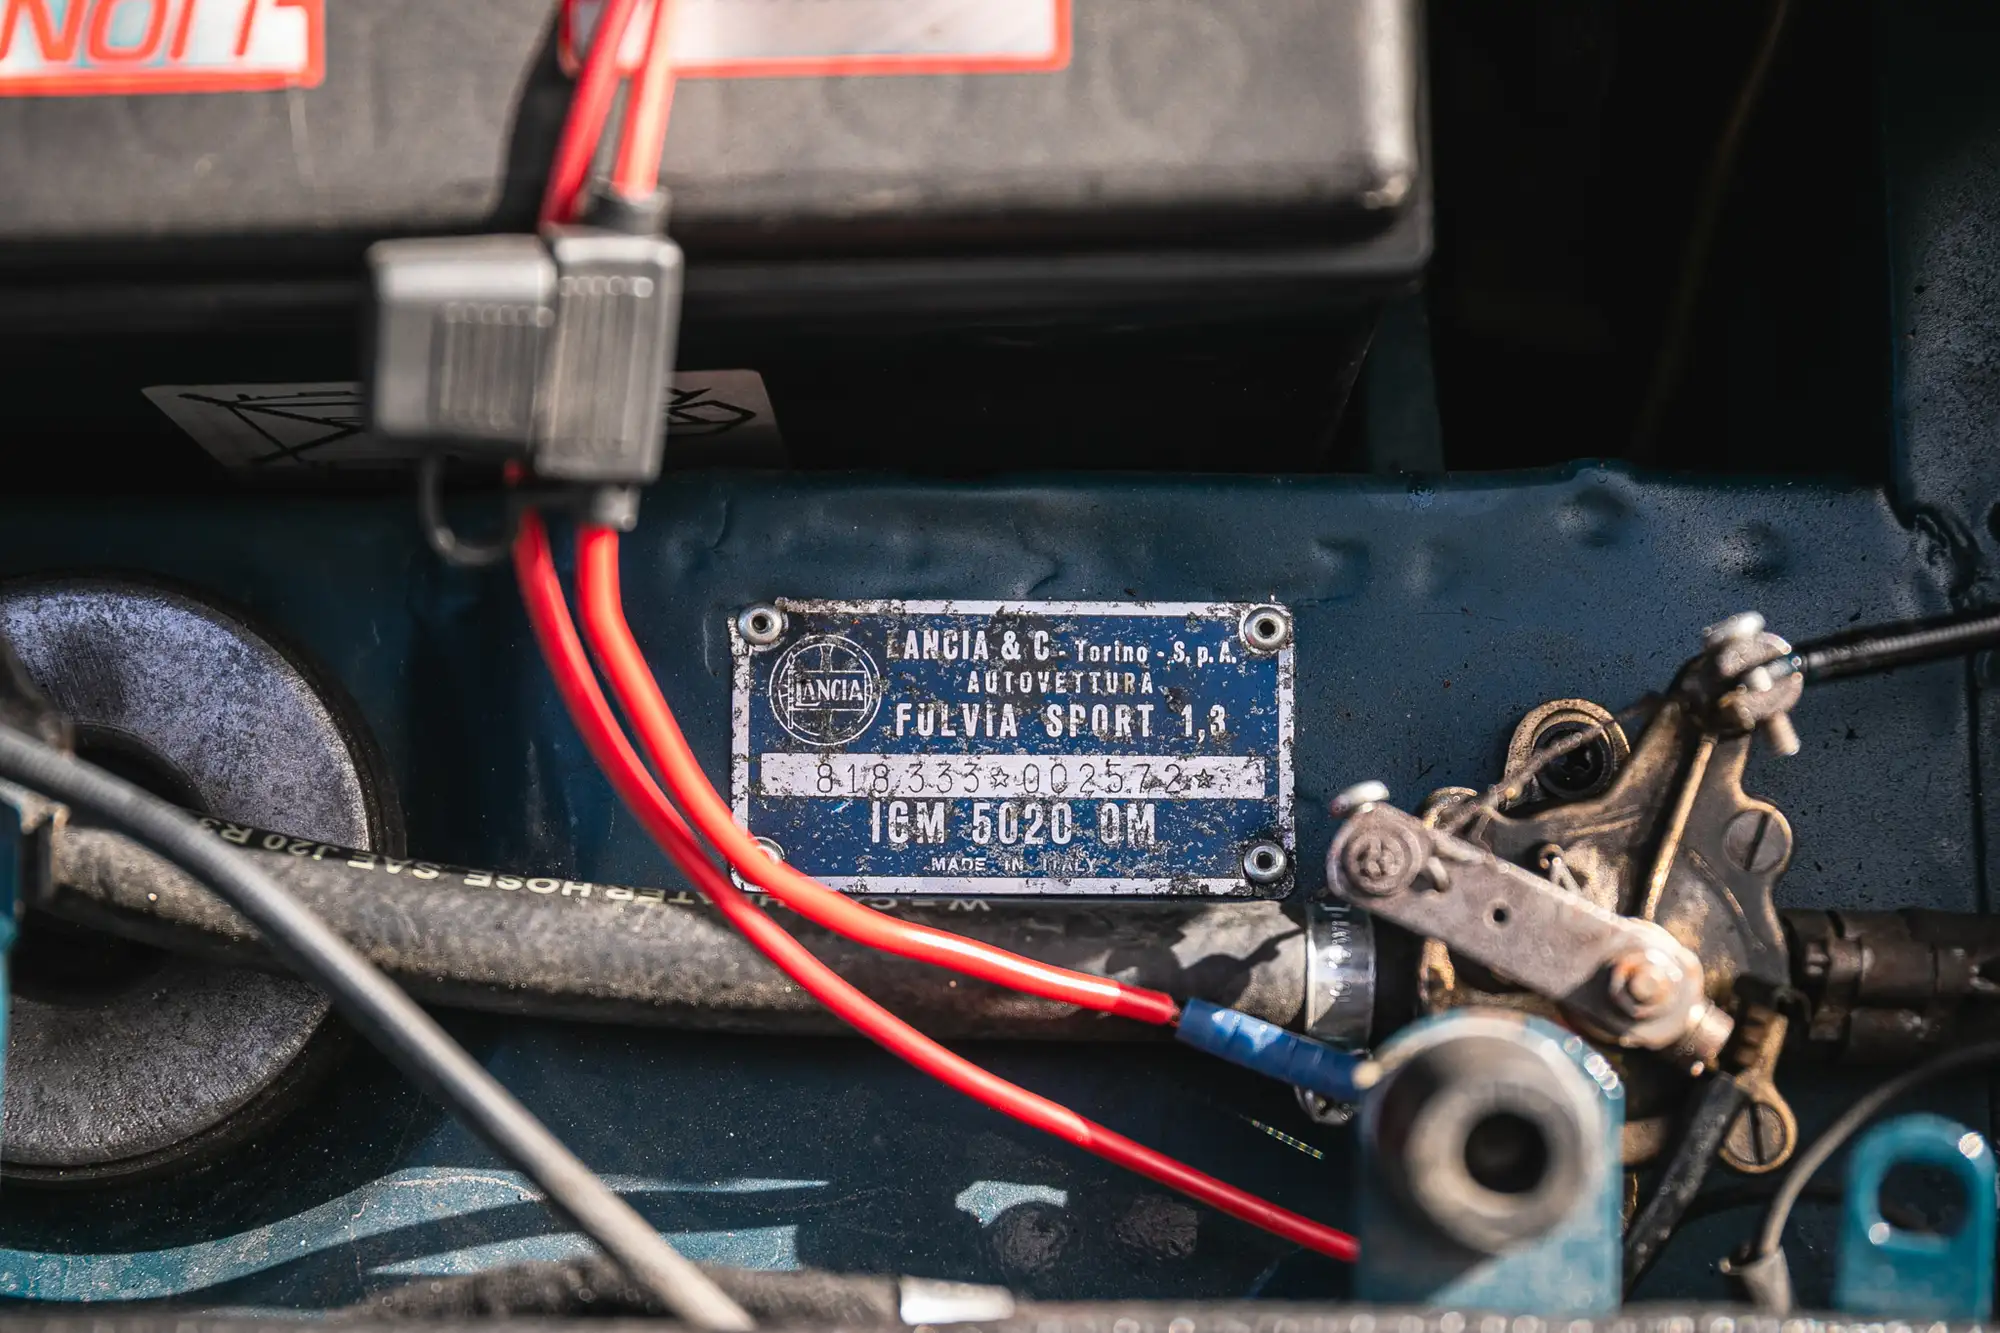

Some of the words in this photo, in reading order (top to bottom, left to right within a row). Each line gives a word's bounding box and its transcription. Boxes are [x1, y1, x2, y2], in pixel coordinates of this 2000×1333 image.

[886, 630, 989, 660] LANCIA
[1002, 631, 1022, 661] &
[1074, 640, 1149, 663] Torino
[795, 678, 865, 706] LANCIA
[967, 671, 1154, 694] AUTOVETTURA
[896, 703, 1018, 738] FULVIA
[1046, 703, 1155, 738] SPORT
[1180, 703, 1227, 743] 1,3
[871, 800, 946, 844] IGM
[971, 801, 1073, 845] 5020
[262, 833, 340, 861] J20
[347, 850, 441, 880] SAE
[931, 857, 987, 872] MADE
[1004, 857, 1024, 872] IN
[1042, 858, 1096, 872] ITALY
[463, 869, 593, 898] HOSE
